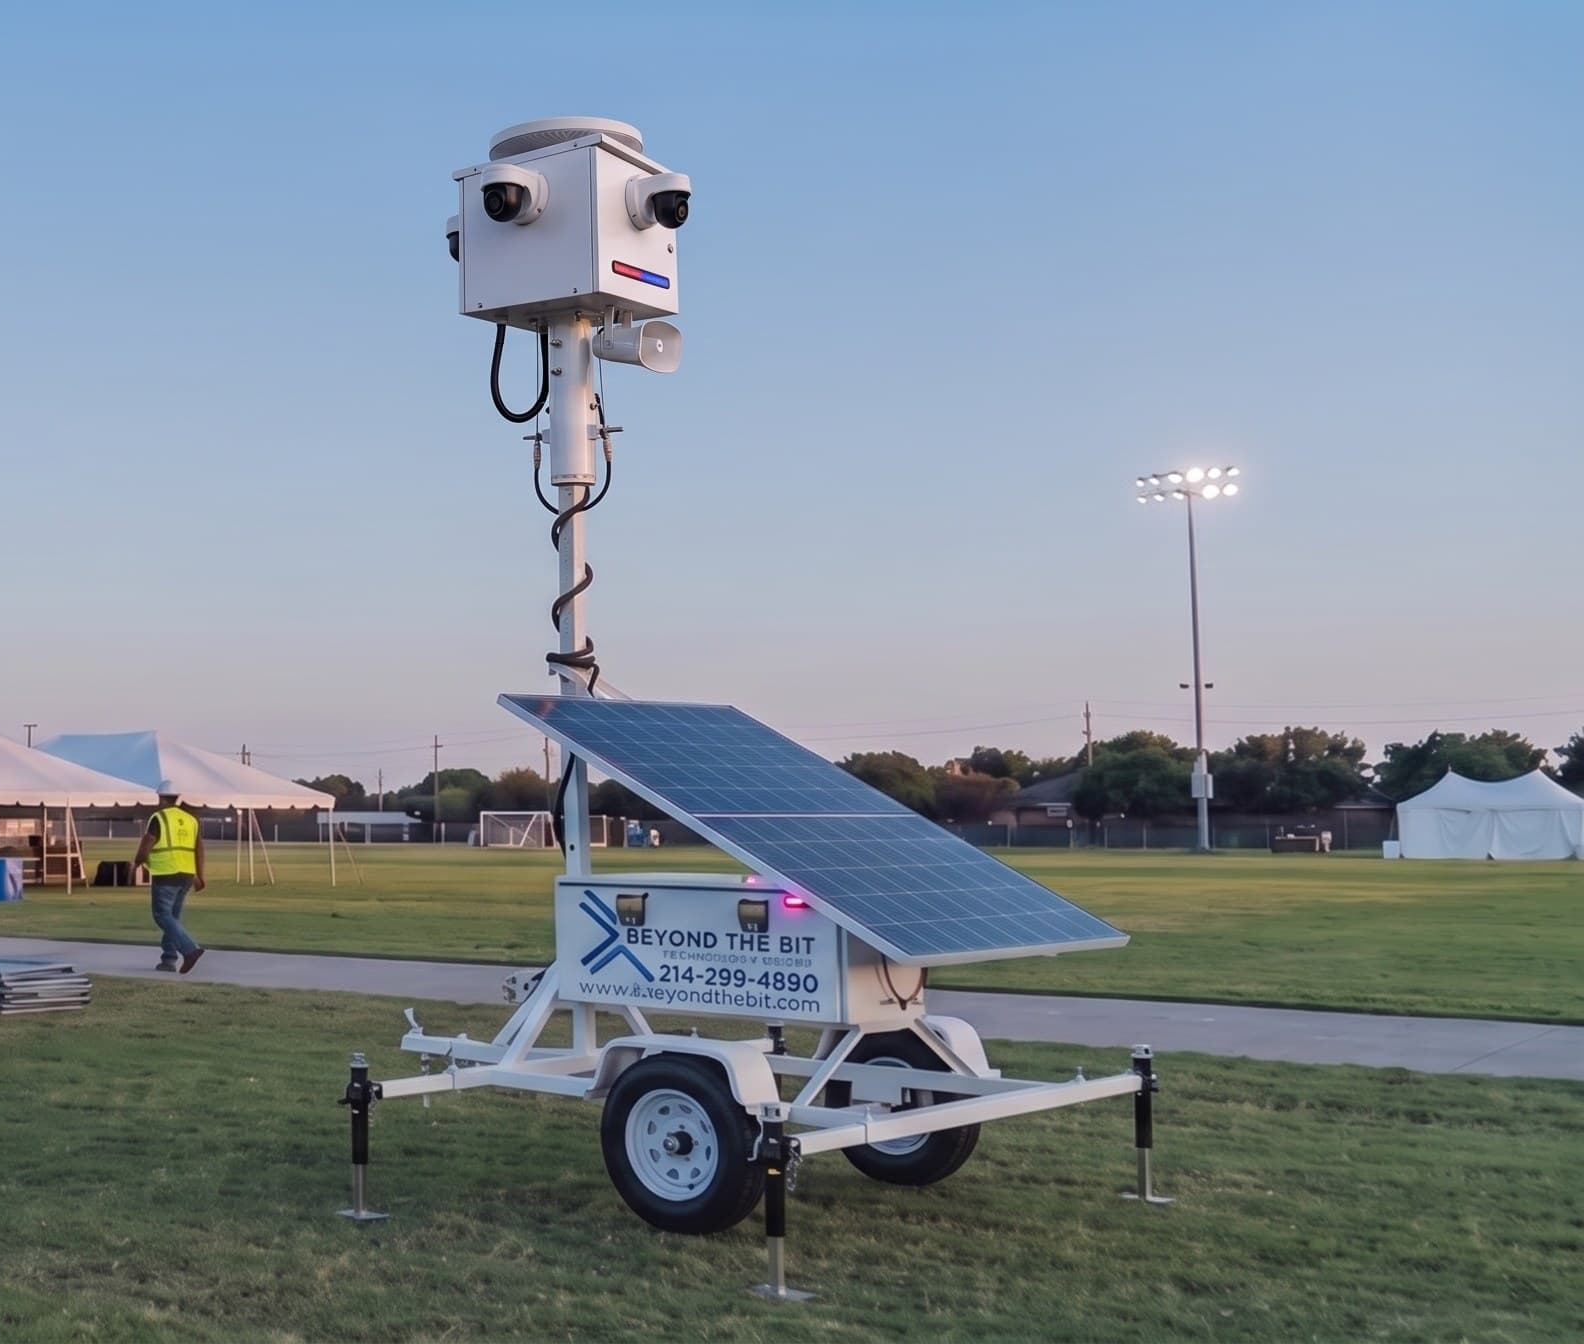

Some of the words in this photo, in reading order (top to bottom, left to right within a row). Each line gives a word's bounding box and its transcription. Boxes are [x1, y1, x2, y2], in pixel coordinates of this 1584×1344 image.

[627, 928, 717, 949] BEYOND
[726, 933, 770, 952] THE
[780, 936, 815, 955] BIT
[659, 965, 819, 993] 214-299-4890
